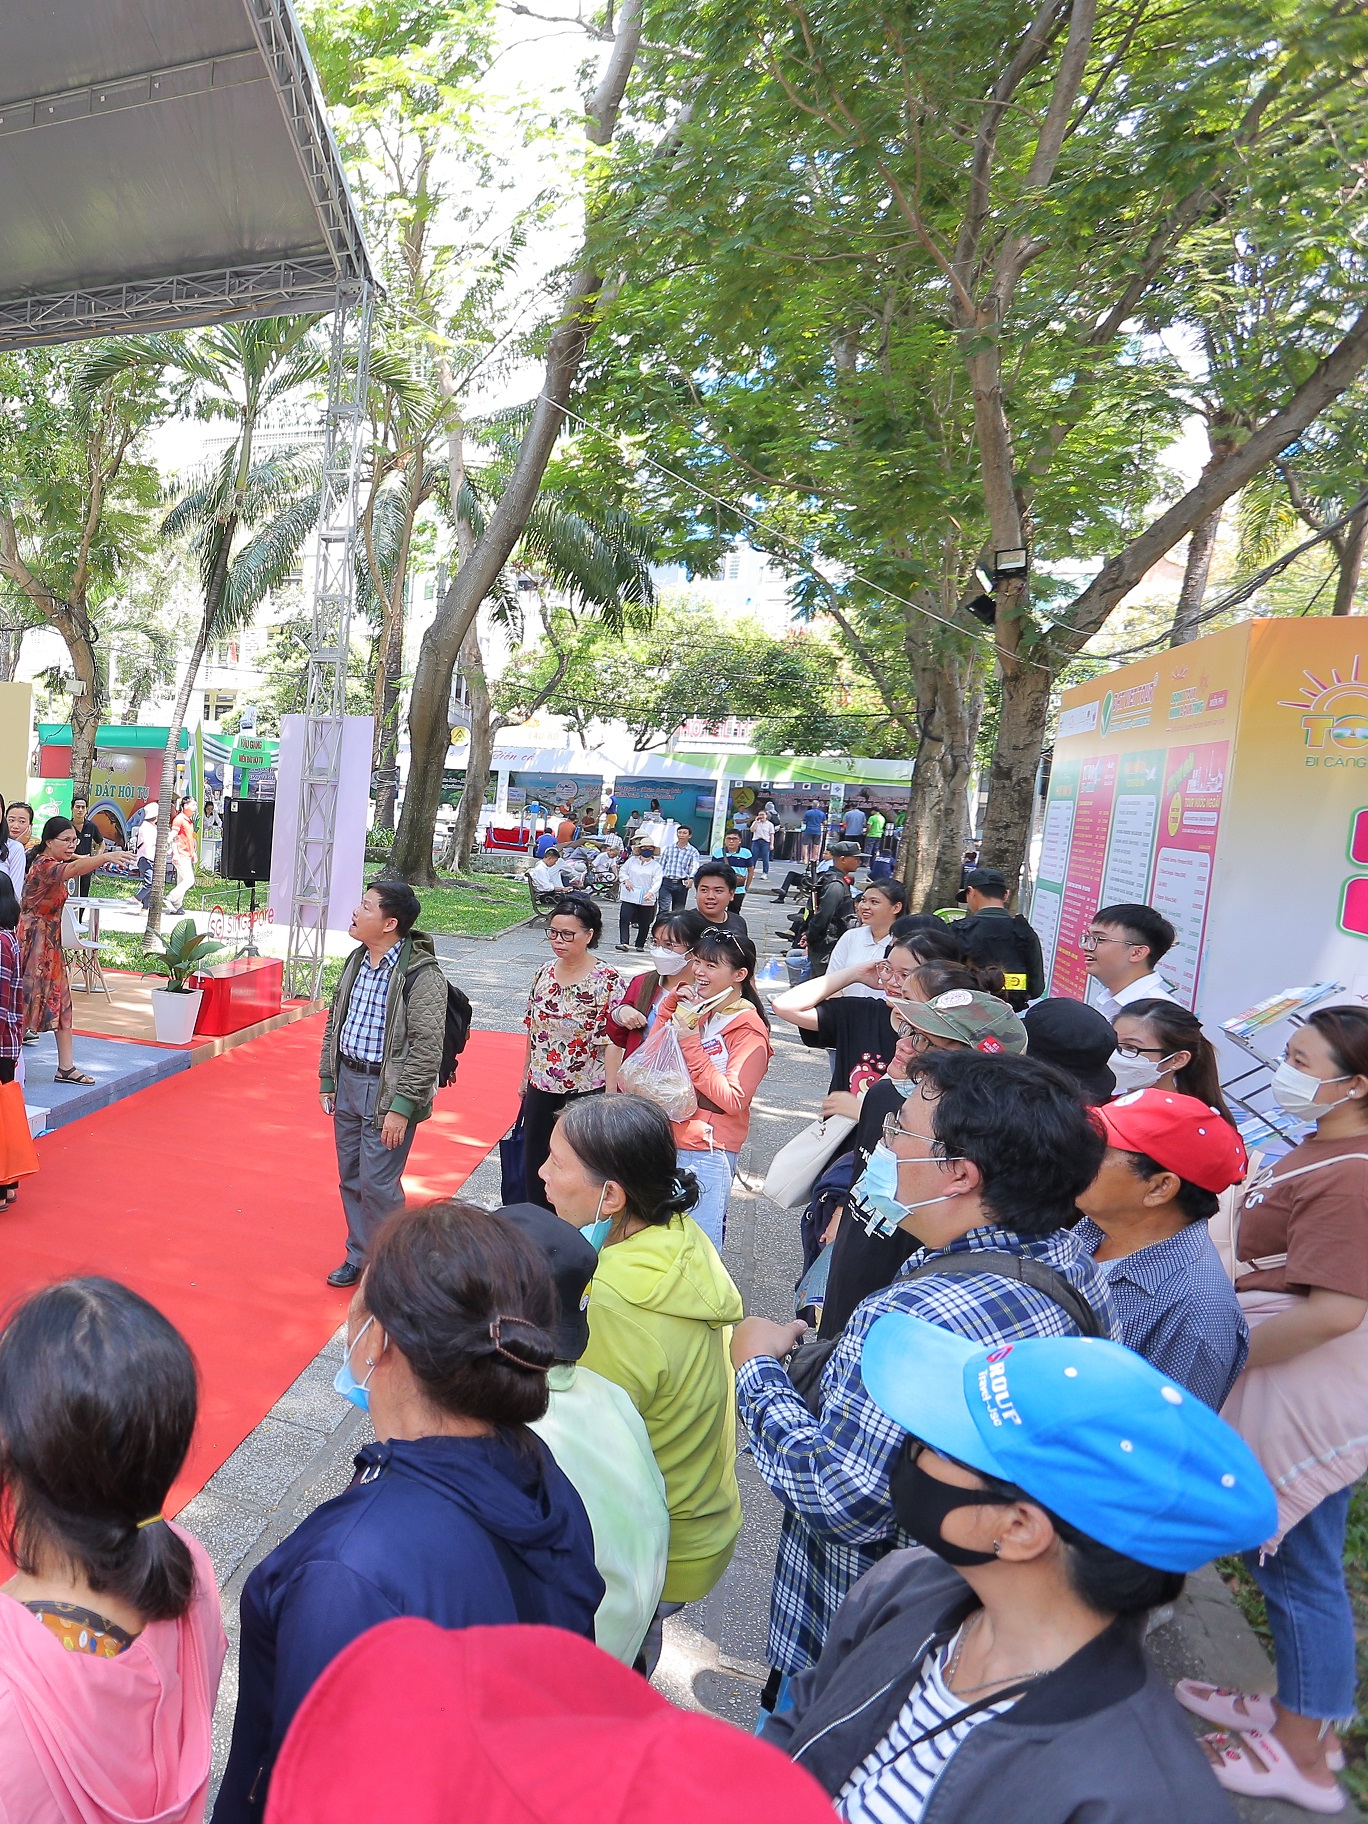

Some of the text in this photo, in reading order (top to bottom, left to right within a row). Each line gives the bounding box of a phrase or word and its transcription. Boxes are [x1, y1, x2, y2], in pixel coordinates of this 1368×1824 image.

[1305, 756, 1320, 767] ĐI
[95, 779, 150, 803] ĐẤT HỘI TỤ
